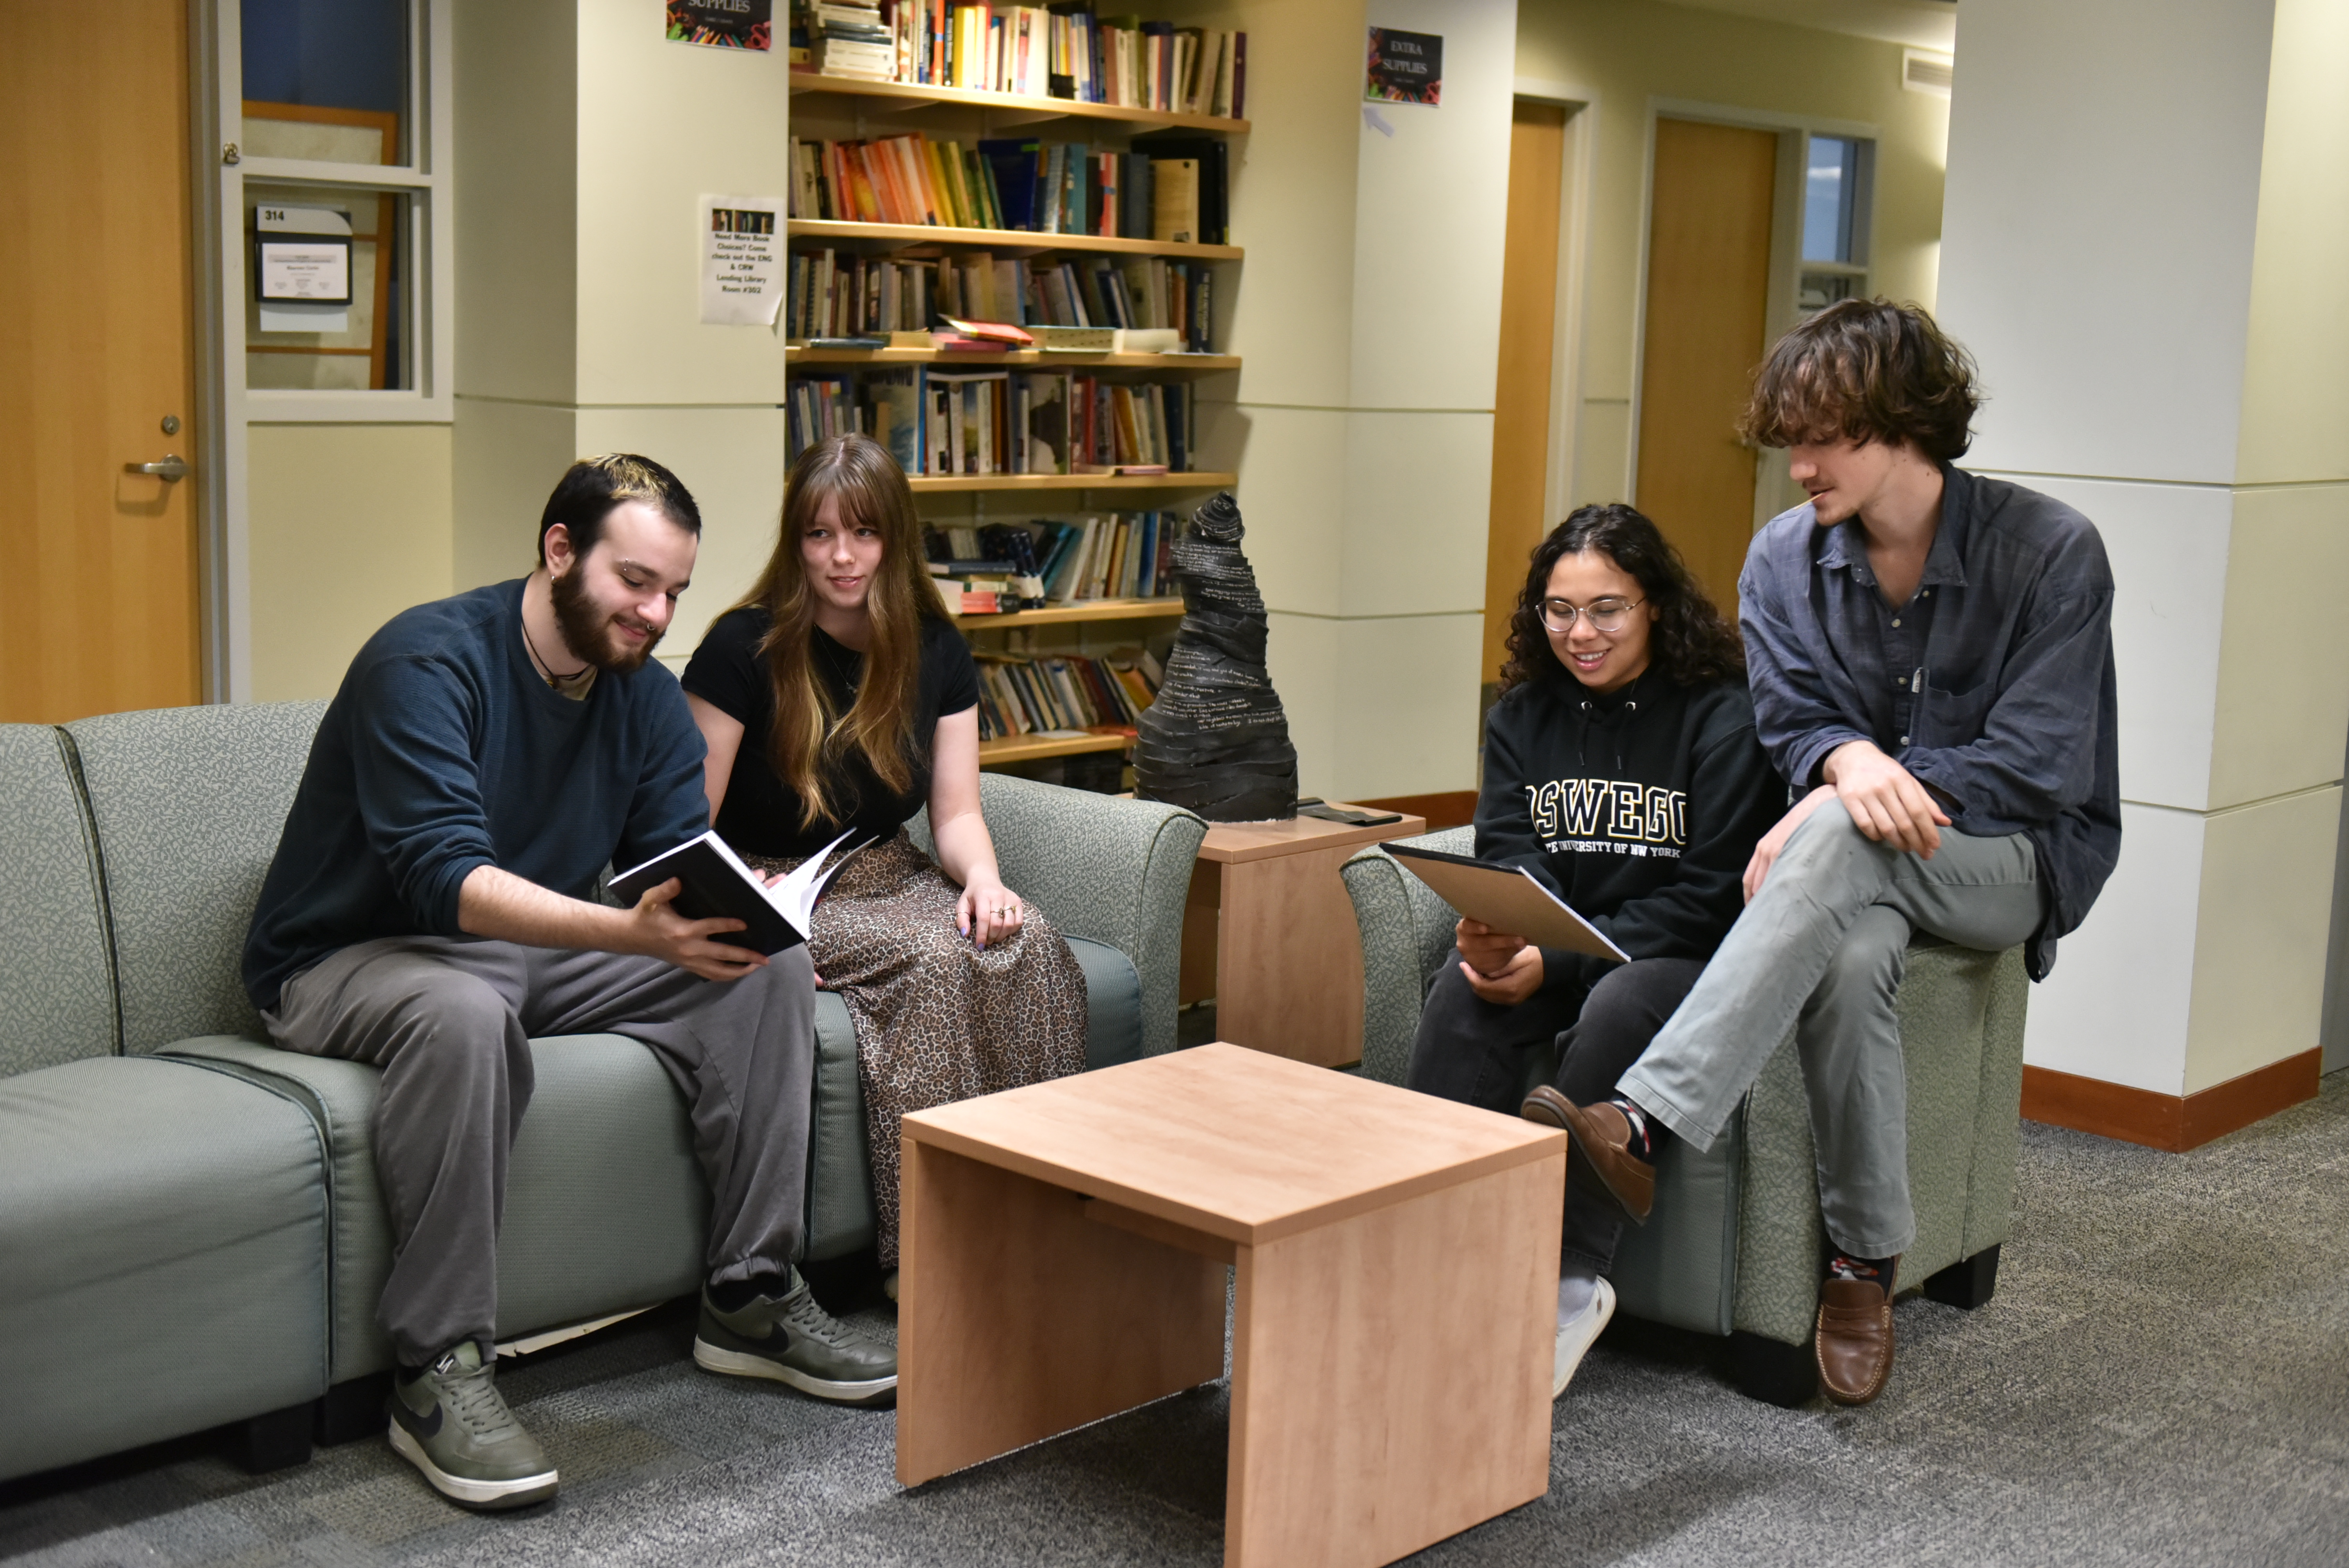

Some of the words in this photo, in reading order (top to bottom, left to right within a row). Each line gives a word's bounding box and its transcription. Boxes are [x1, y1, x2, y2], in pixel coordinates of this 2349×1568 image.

[1390, 41, 1423, 55] EXTRA
[1383, 59, 1428, 74] SUPPLIES
[265, 210, 284, 221] 314
[745, 275, 766, 284] Library
[1614, 843, 1629, 854] OF
[1650, 847, 1681, 858] YORK
